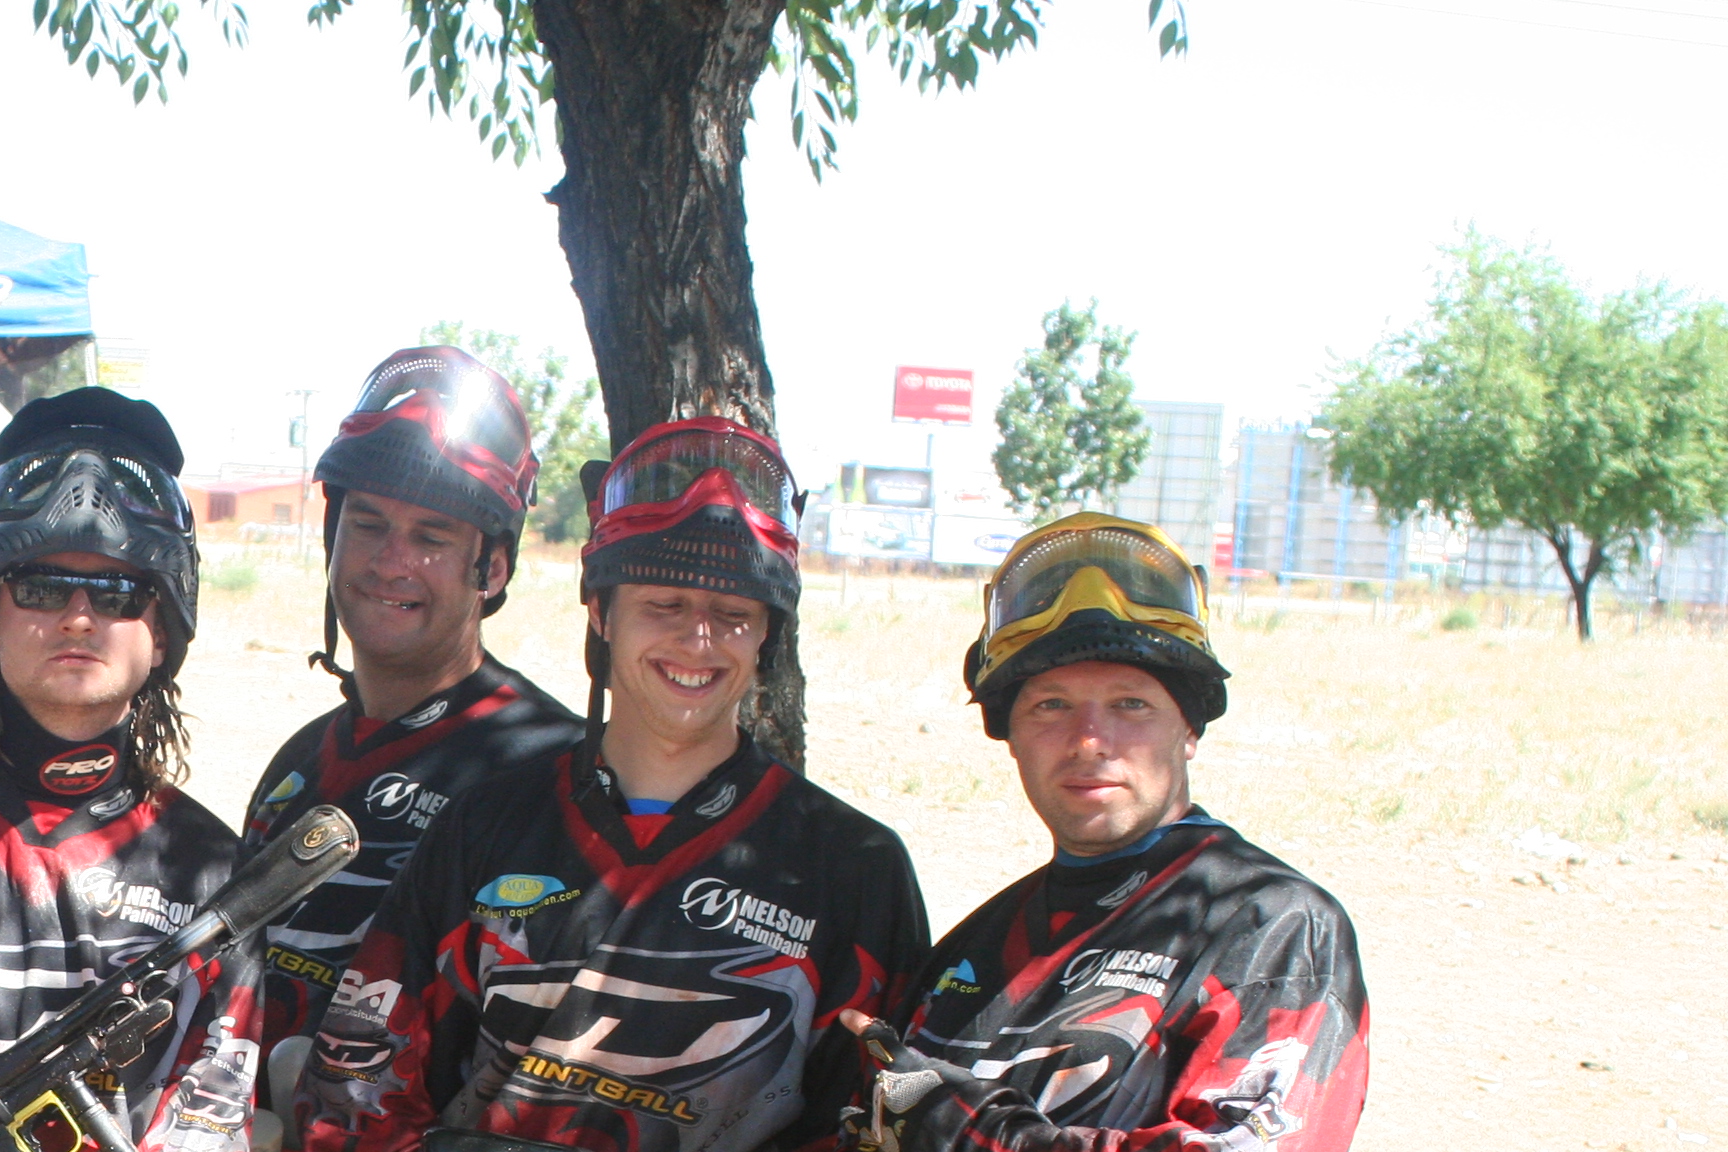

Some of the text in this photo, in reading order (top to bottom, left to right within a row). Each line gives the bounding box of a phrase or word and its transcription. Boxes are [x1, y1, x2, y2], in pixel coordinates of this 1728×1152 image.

[926, 376, 972, 391] TOYOTA
[44, 754, 114, 775] PRO
[125, 884, 196, 926] NELSON
[741, 894, 817, 942] NELSON
[733, 918, 809, 960] Paintballs
[1106, 949, 1180, 980] NELSON
[330, 969, 404, 1016] SA
[1094, 971, 1167, 998] Paintballs
